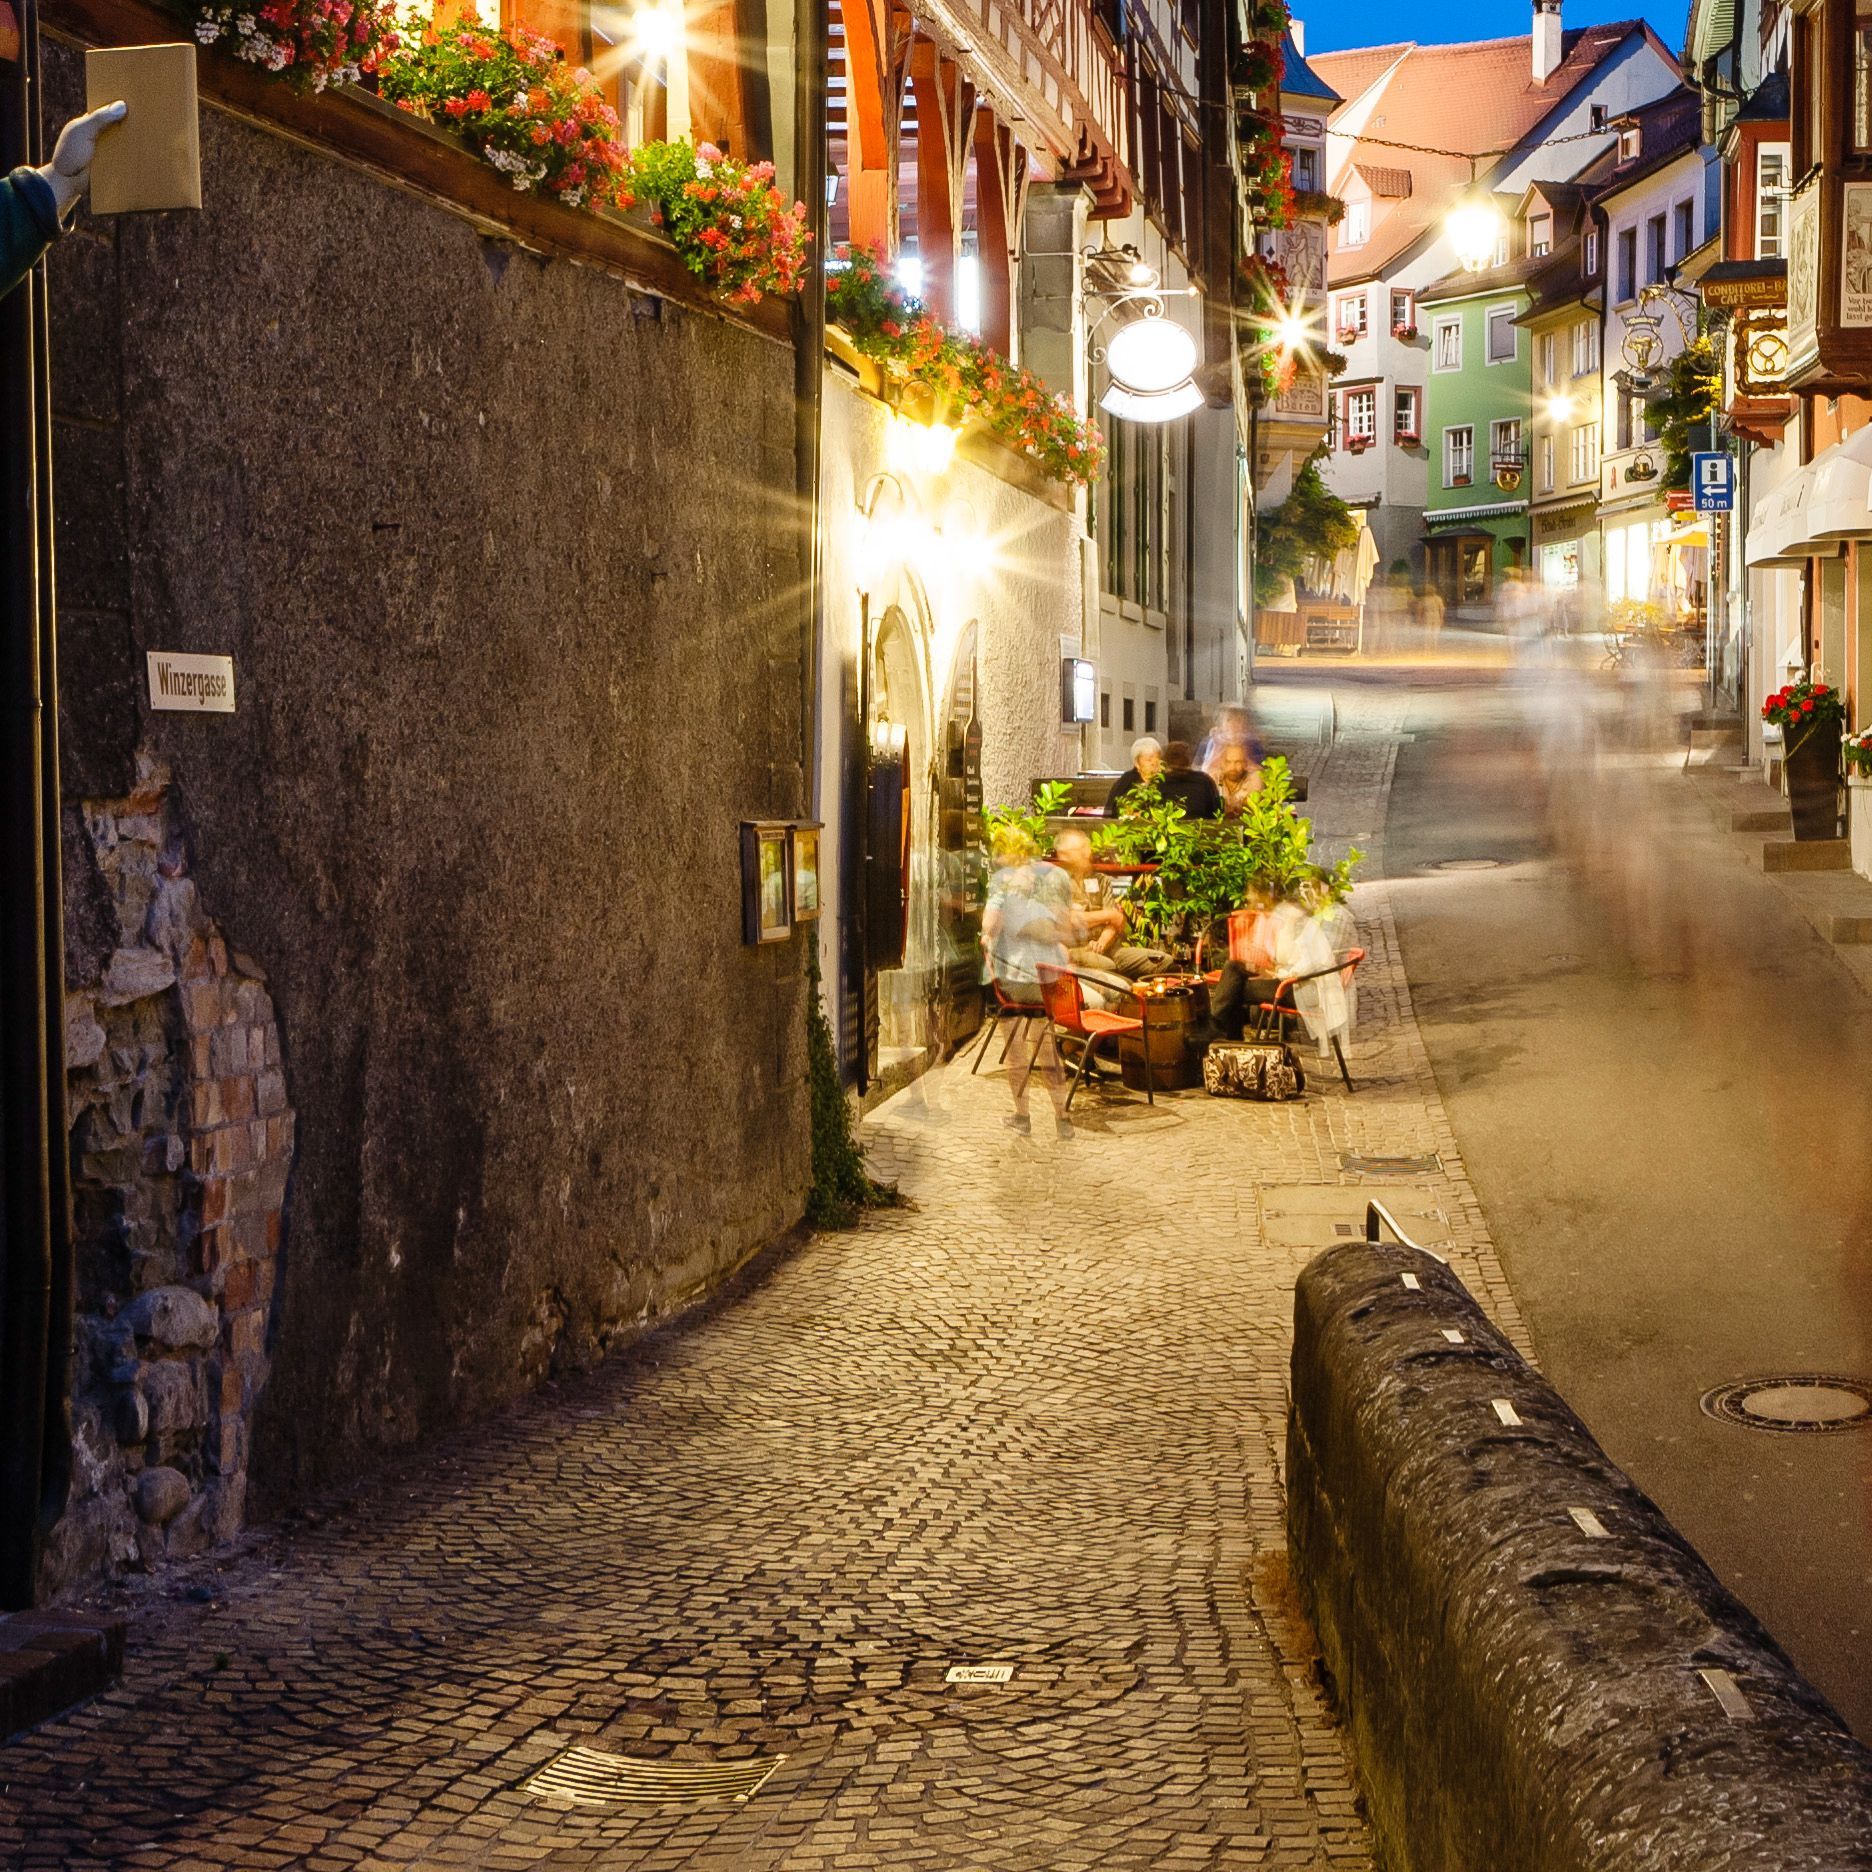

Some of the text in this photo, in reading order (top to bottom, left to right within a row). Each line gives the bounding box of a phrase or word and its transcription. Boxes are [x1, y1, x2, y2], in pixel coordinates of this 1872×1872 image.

[1701, 498, 1715, 509] 50
[1717, 500, 1728, 509] m
[157, 661, 227, 705] Winzergasse
